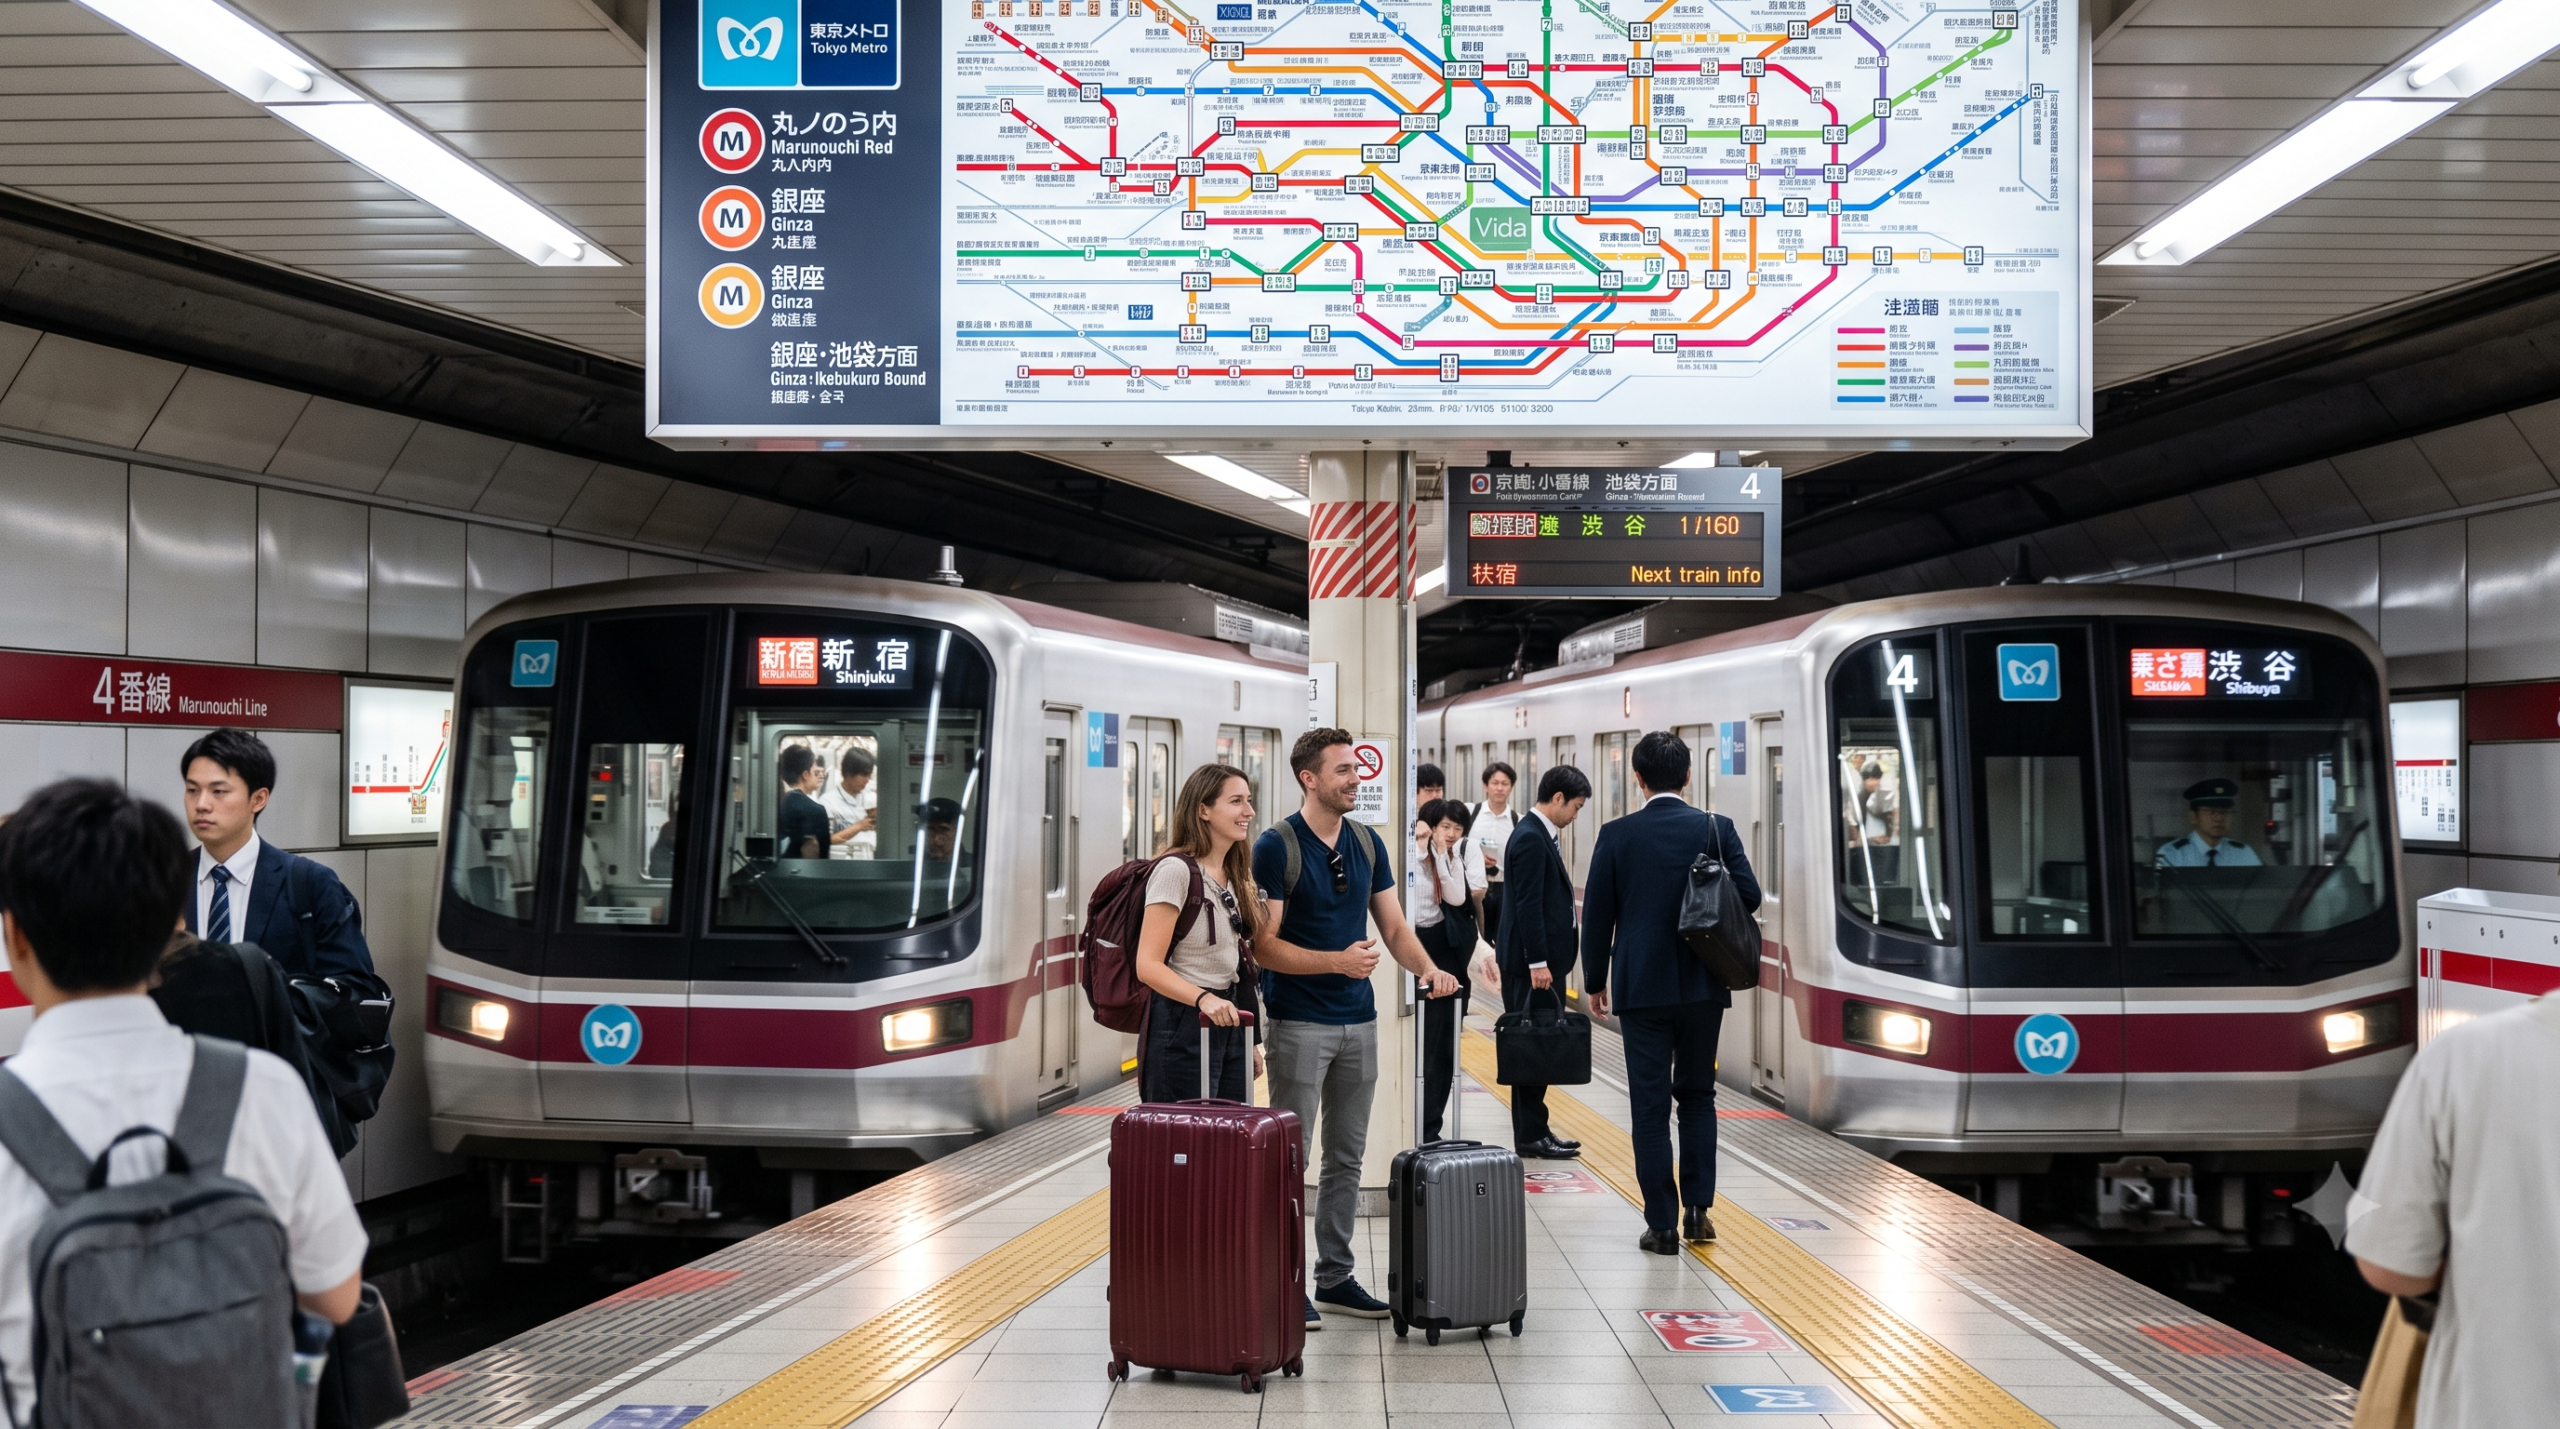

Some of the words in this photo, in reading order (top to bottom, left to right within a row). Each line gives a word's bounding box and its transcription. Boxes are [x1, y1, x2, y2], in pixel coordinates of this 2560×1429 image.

[810, 23, 889, 39] 東京メトロ
[811, 42, 847, 56] Tokyo
[851, 42, 888, 54] Metro
[772, 112, 897, 137] 丸ノのう内
[719, 131, 745, 152] M
[771, 139, 860, 155] Marunouchi
[864, 139, 893, 155] Red
[771, 187, 826, 214] 銀座
[719, 208, 745, 229] M
[771, 216, 813, 232] Ginza
[1475, 217, 1527, 238] Vida
[771, 265, 825, 291] 銀座
[719, 286, 745, 307] M
[771, 294, 813, 309] Ginza
[770, 341, 919, 368] 銀座・池袋方面
[884, 371, 927, 386] Bound
[1740, 472, 1762, 500] 4
[1631, 565, 1671, 583] Next
[1679, 566, 1720, 583] train
[1727, 565, 1761, 584] info
[836, 671, 896, 687] Shinjuku
[1887, 655, 1918, 693] 4
[178, 696, 243, 717] Marunouchi
[245, 698, 268, 718] Line
